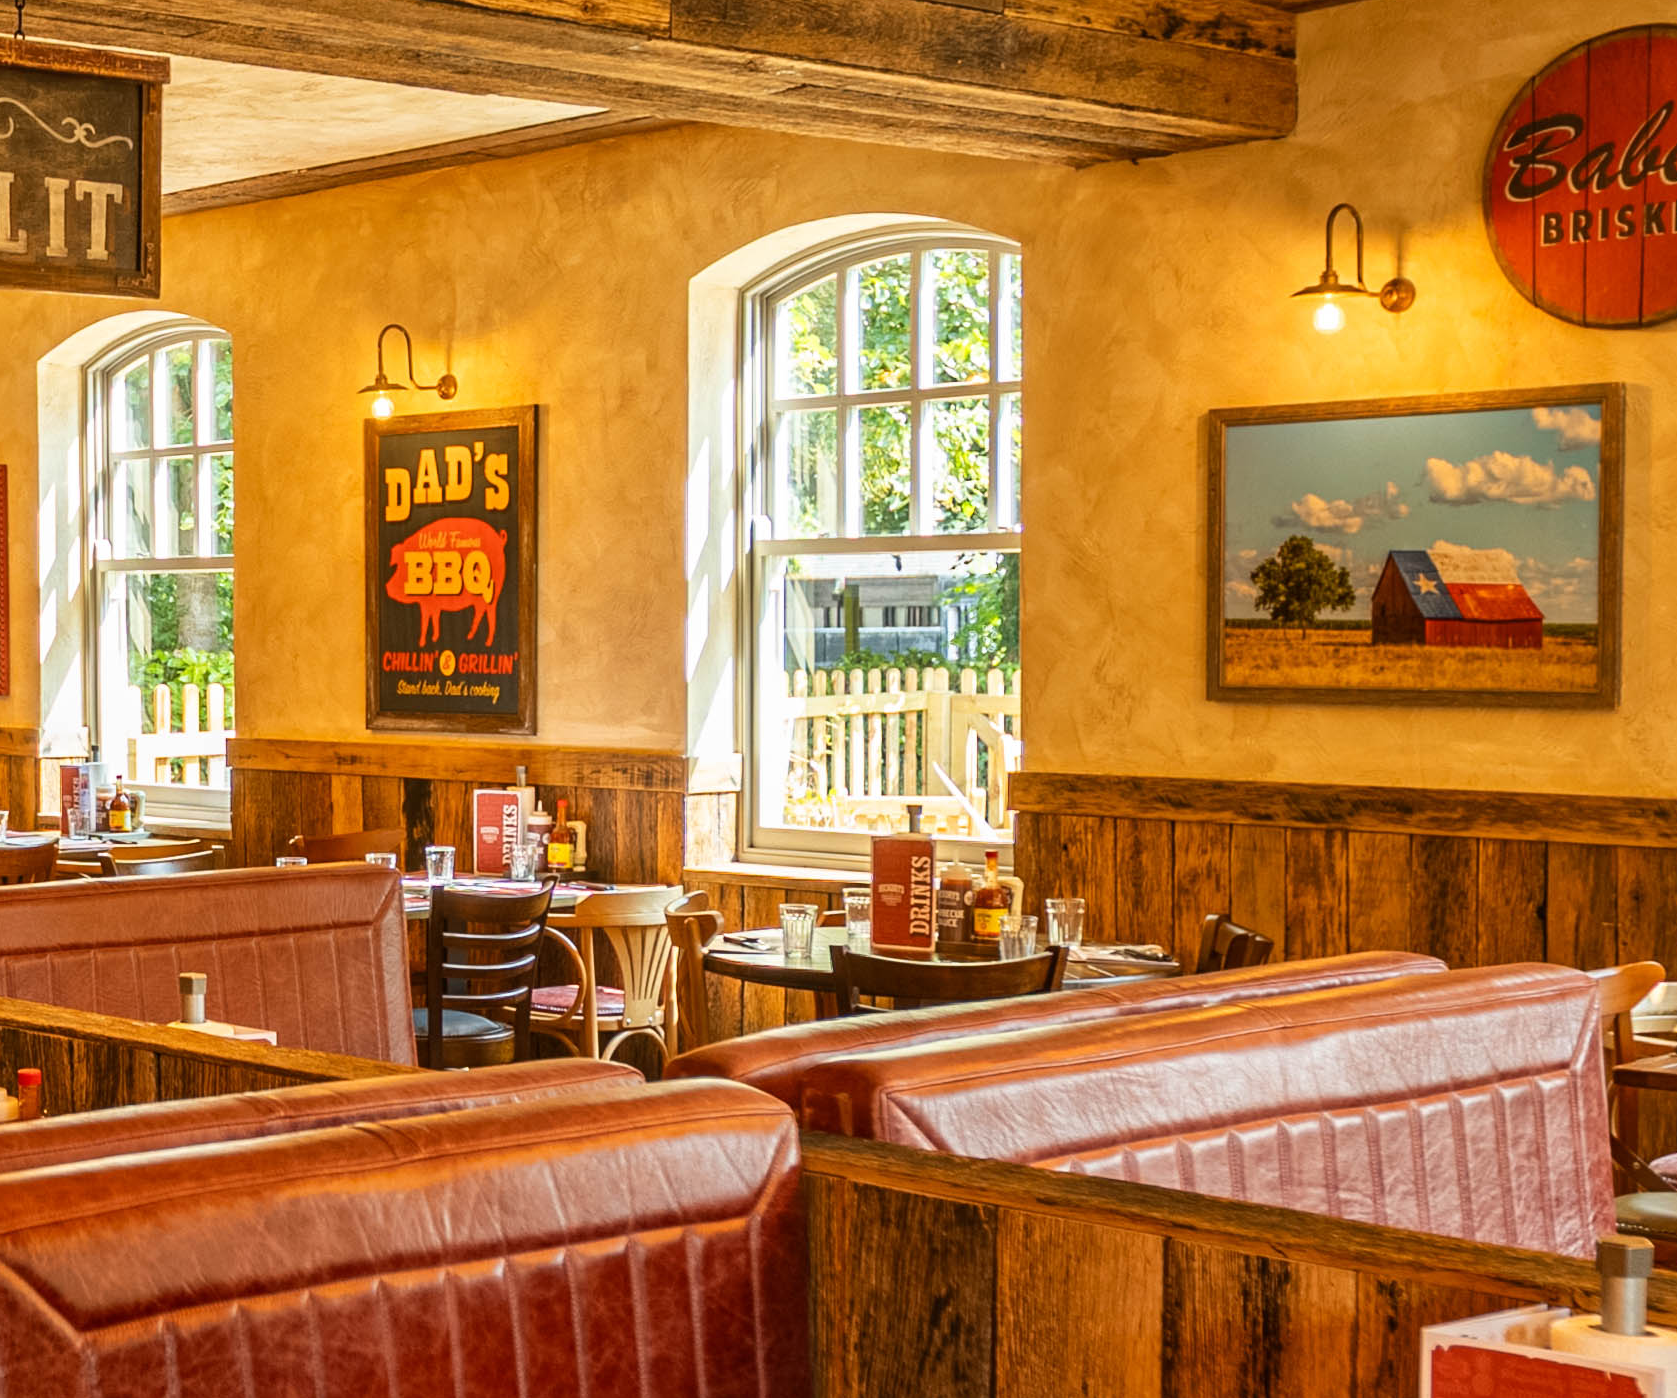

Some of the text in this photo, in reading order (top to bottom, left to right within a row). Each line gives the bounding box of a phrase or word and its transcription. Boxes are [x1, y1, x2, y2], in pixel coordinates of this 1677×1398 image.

[43, 179, 125, 264] IT
[385, 441, 510, 522] DAD'S
[419, 532, 447, 549] World
[404, 550, 494, 604] BBQ
[382, 650, 439, 672] CHILLIN'
[458, 652, 518, 674] GRILLIN'
[502, 804, 517, 866] DRINKS
[909, 856, 931, 935] DRINKS
